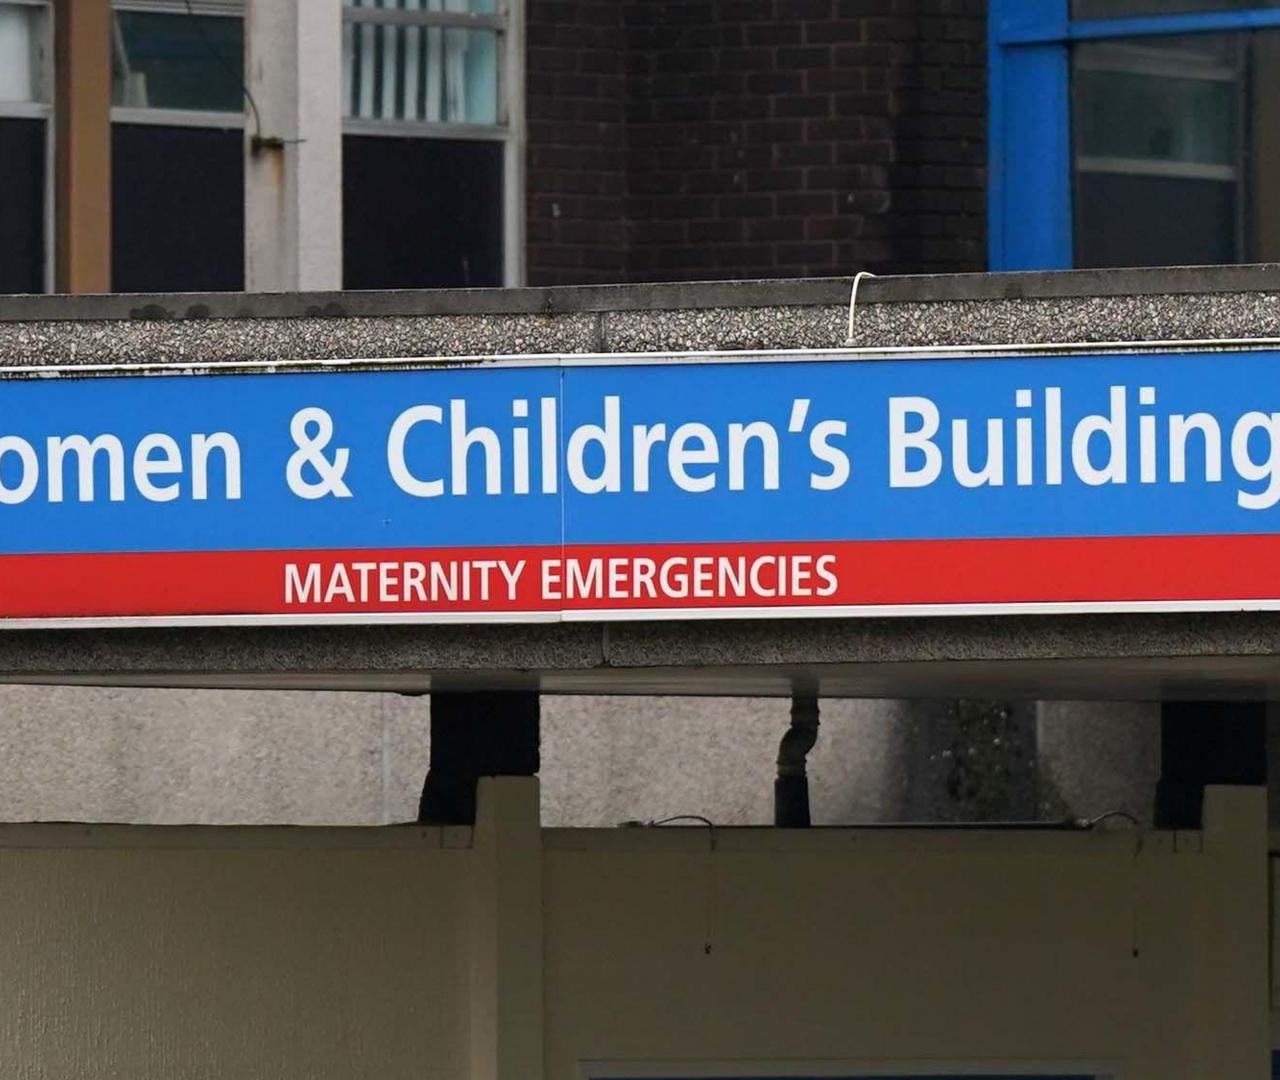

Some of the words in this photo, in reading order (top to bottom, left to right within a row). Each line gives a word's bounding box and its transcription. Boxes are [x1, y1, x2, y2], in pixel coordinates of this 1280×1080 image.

[286, 406, 353, 499] &
[386, 395, 851, 497] Children's
[284, 559, 527, 604] MATERNITY
[541, 553, 839, 600] EMERGENCIES
